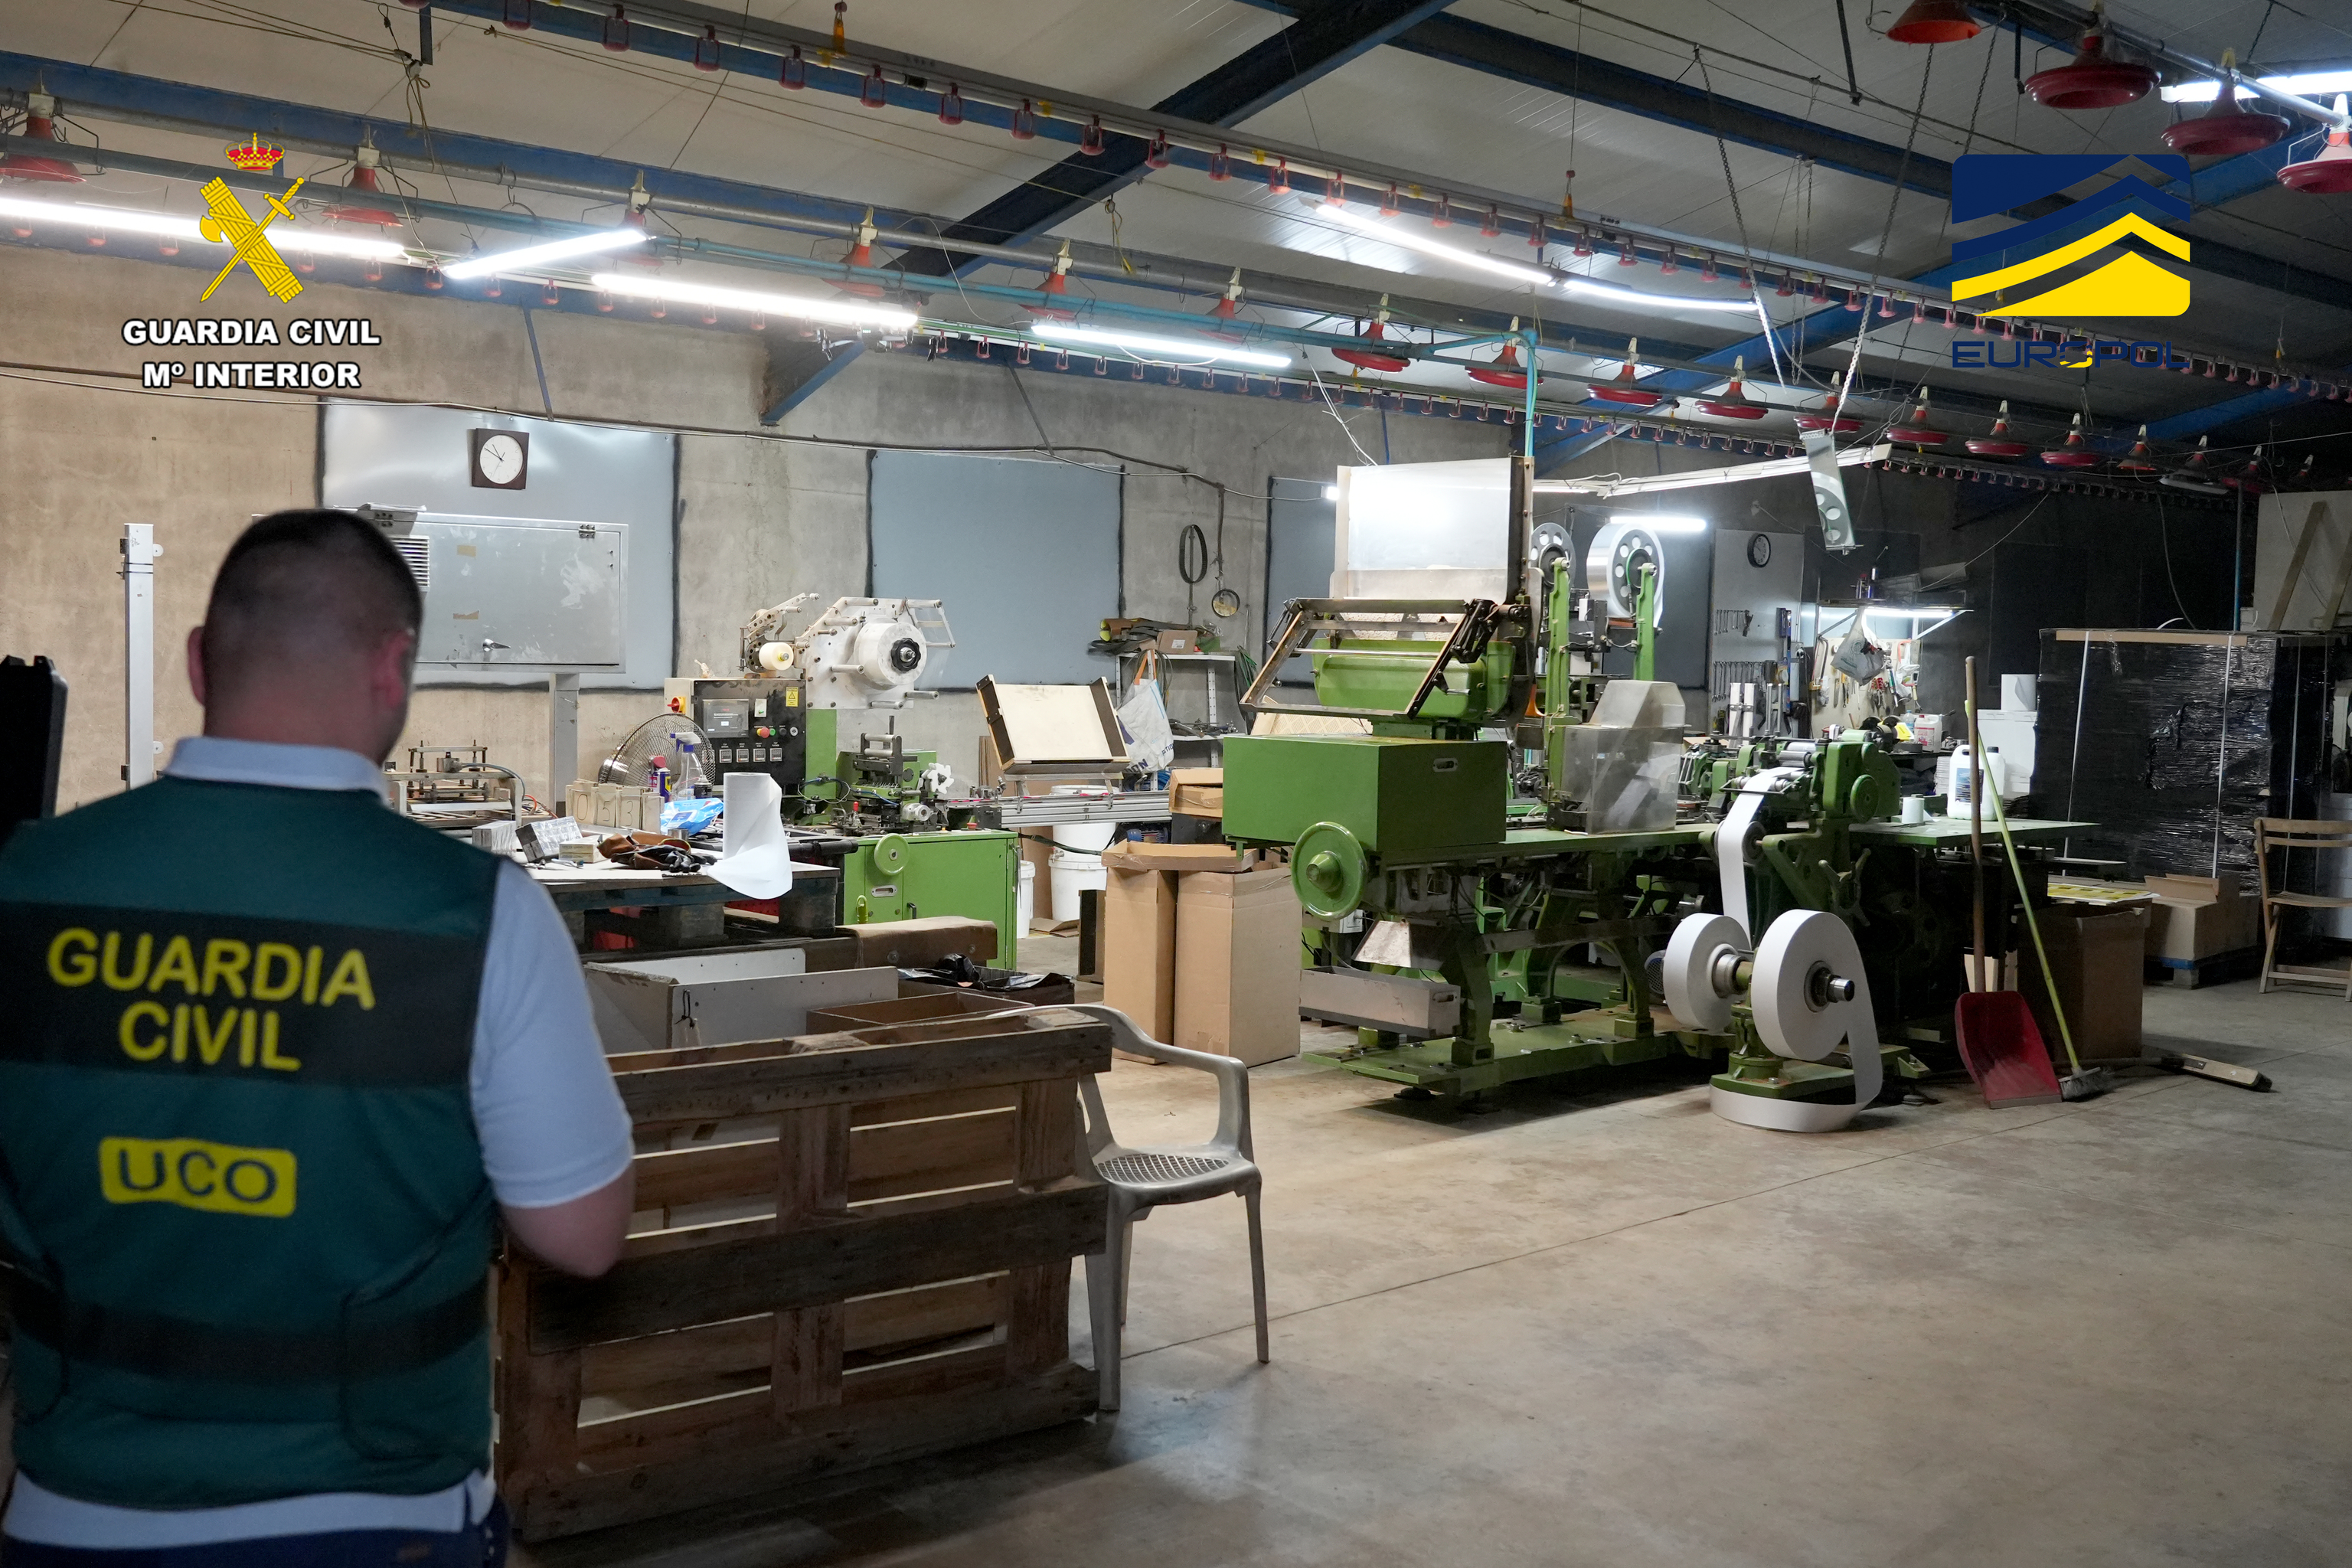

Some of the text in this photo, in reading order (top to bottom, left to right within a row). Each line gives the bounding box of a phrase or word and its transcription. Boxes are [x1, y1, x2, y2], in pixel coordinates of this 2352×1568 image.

[577, 793, 633, 827] 0 5 3
[47, 927, 375, 1010] GUARDIA
[119, 1001, 302, 1072] CIVIL
[119, 1150, 279, 1203] UCO
